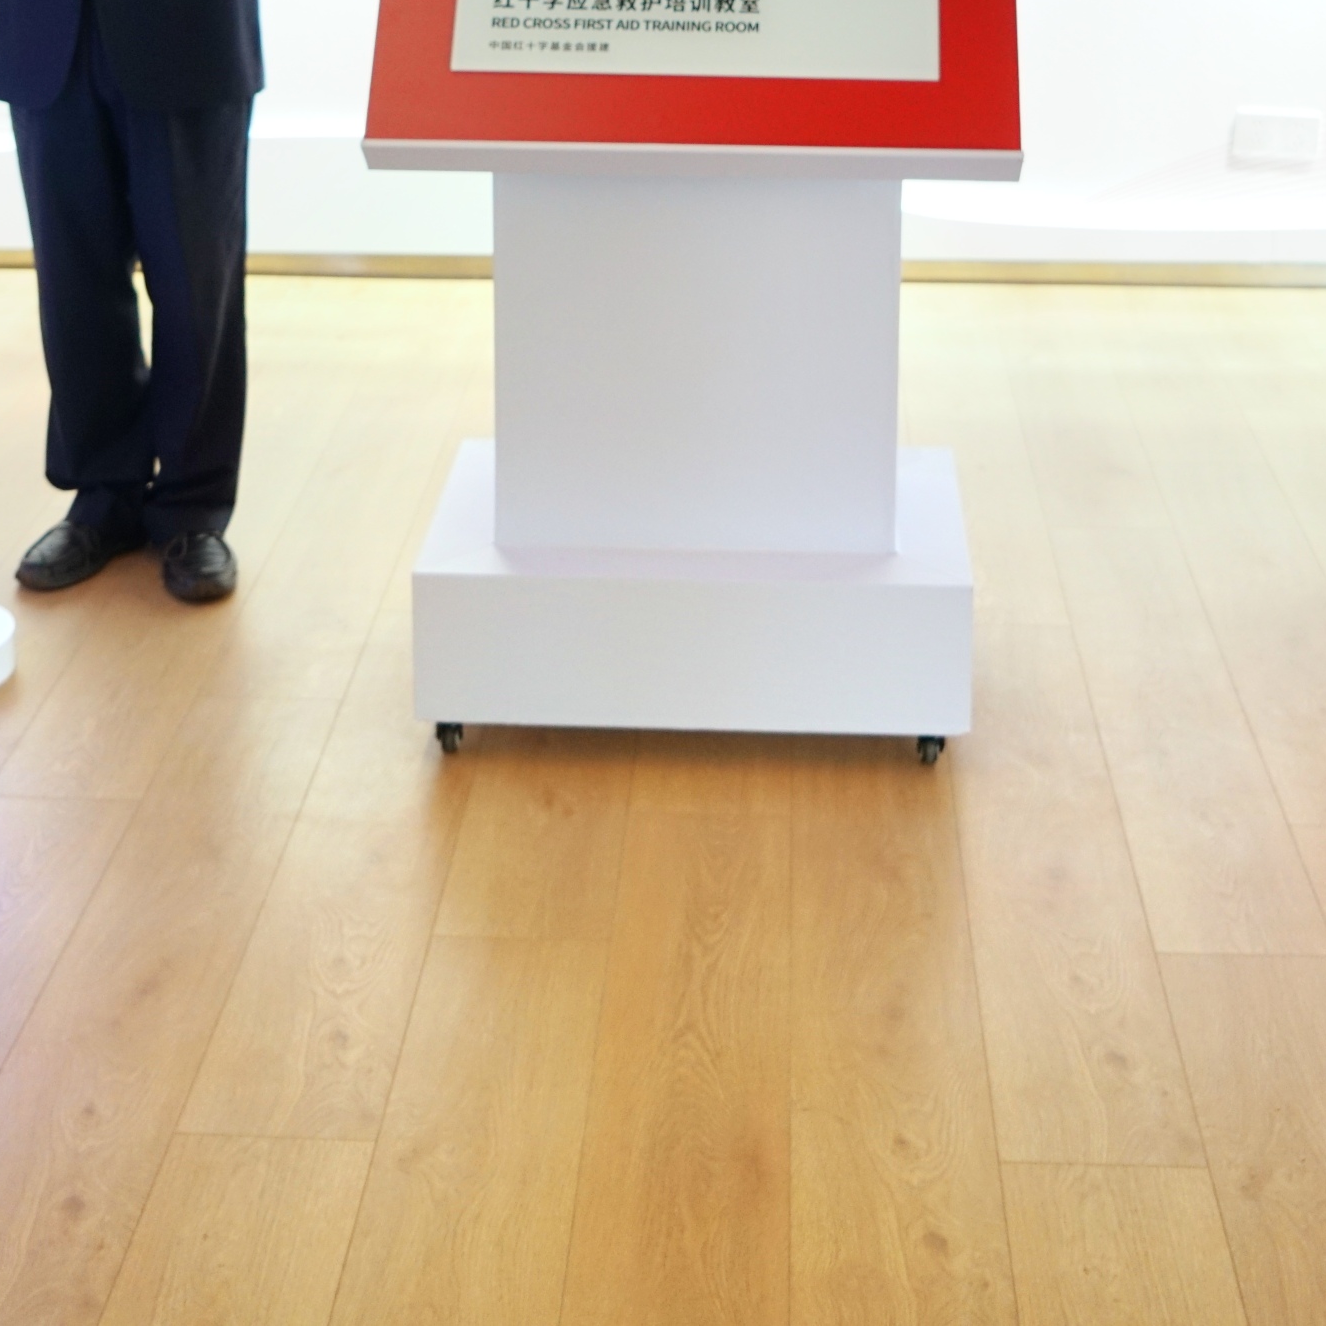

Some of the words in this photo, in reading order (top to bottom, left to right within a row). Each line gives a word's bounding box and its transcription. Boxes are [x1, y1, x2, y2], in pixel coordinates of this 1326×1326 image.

[491, 16, 521, 29] RED
[523, 17, 571, 30] CROSS
[574, 18, 613, 31] FIRST
[616, 19, 640, 31] AID
[643, 19, 712, 33] TRAINING
[715, 20, 760, 33] ROOM
[488, 40, 610, 53] 中国红十字基金会援建
